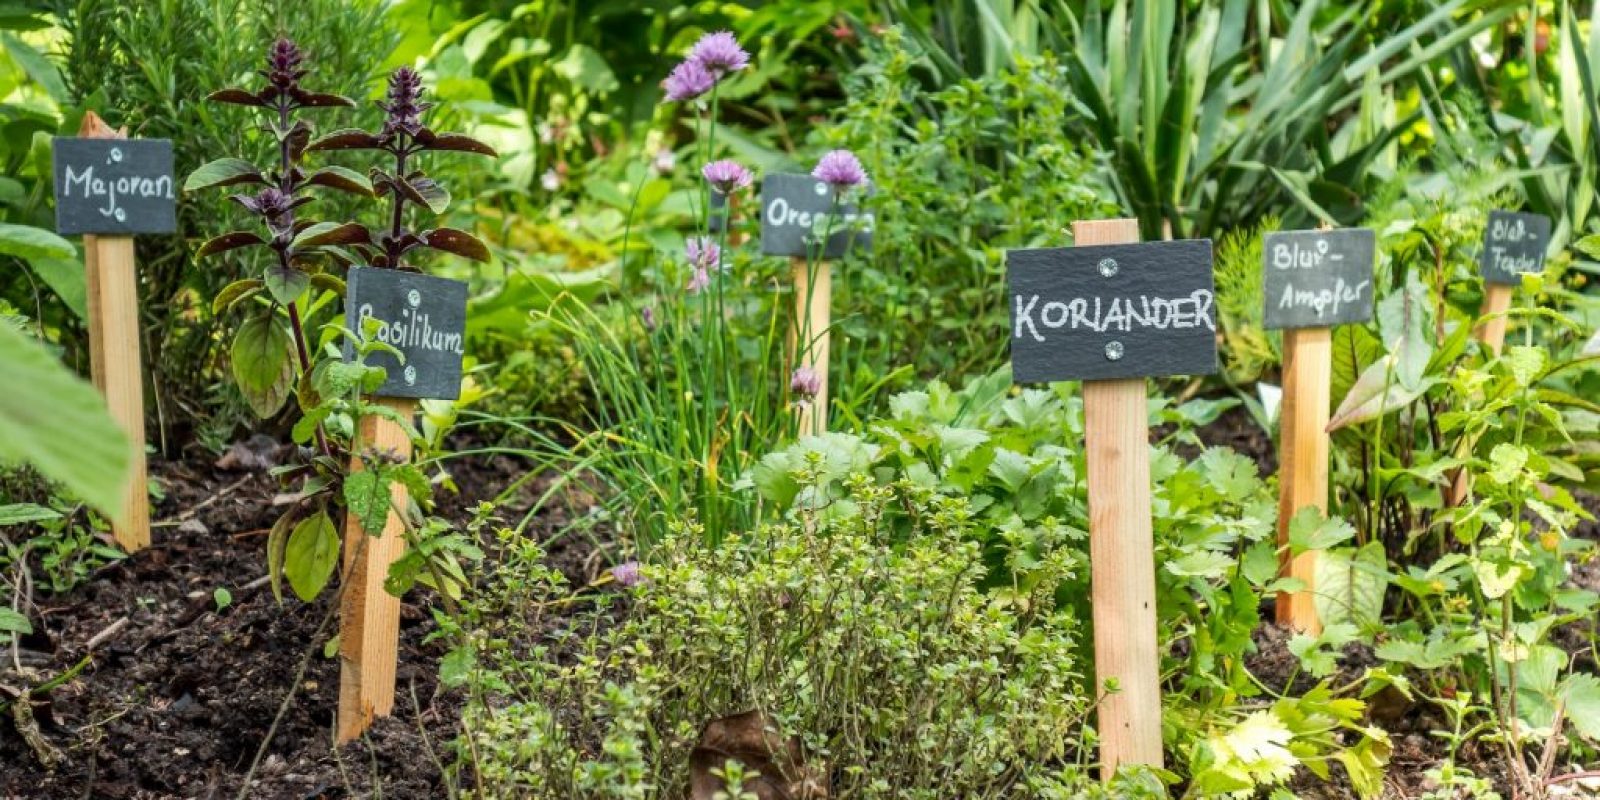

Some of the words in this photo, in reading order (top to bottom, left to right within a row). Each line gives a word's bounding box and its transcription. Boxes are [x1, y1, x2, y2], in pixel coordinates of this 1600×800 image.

[64, 156, 174, 217] Majoran
[1014, 288, 1216, 342] KORIANDER
[1279, 278, 1370, 319] Ampfer
